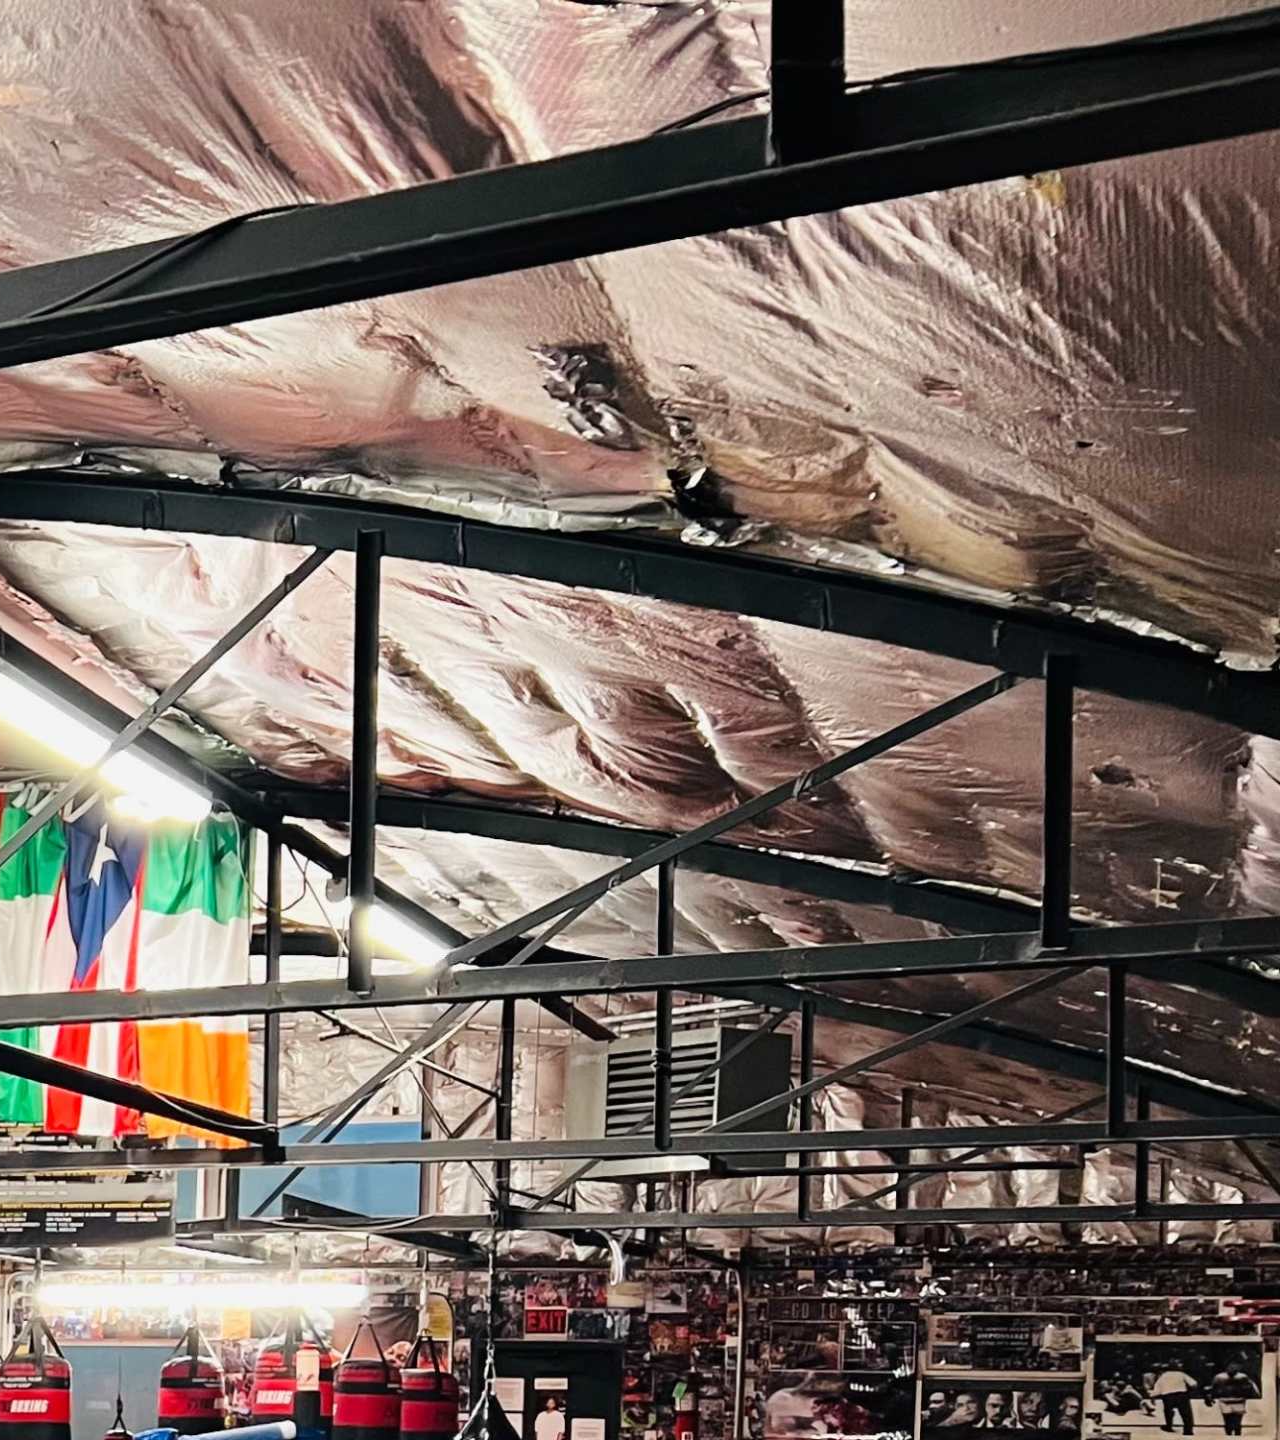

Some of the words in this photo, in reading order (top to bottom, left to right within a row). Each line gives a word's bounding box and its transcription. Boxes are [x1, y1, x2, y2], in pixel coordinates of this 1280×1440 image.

[792, 1302, 809, 1319] GO
[821, 1302, 837, 1319] TO
[526, 1309, 566, 1334] EXIT
[9, 1399, 49, 1413] BOXING
